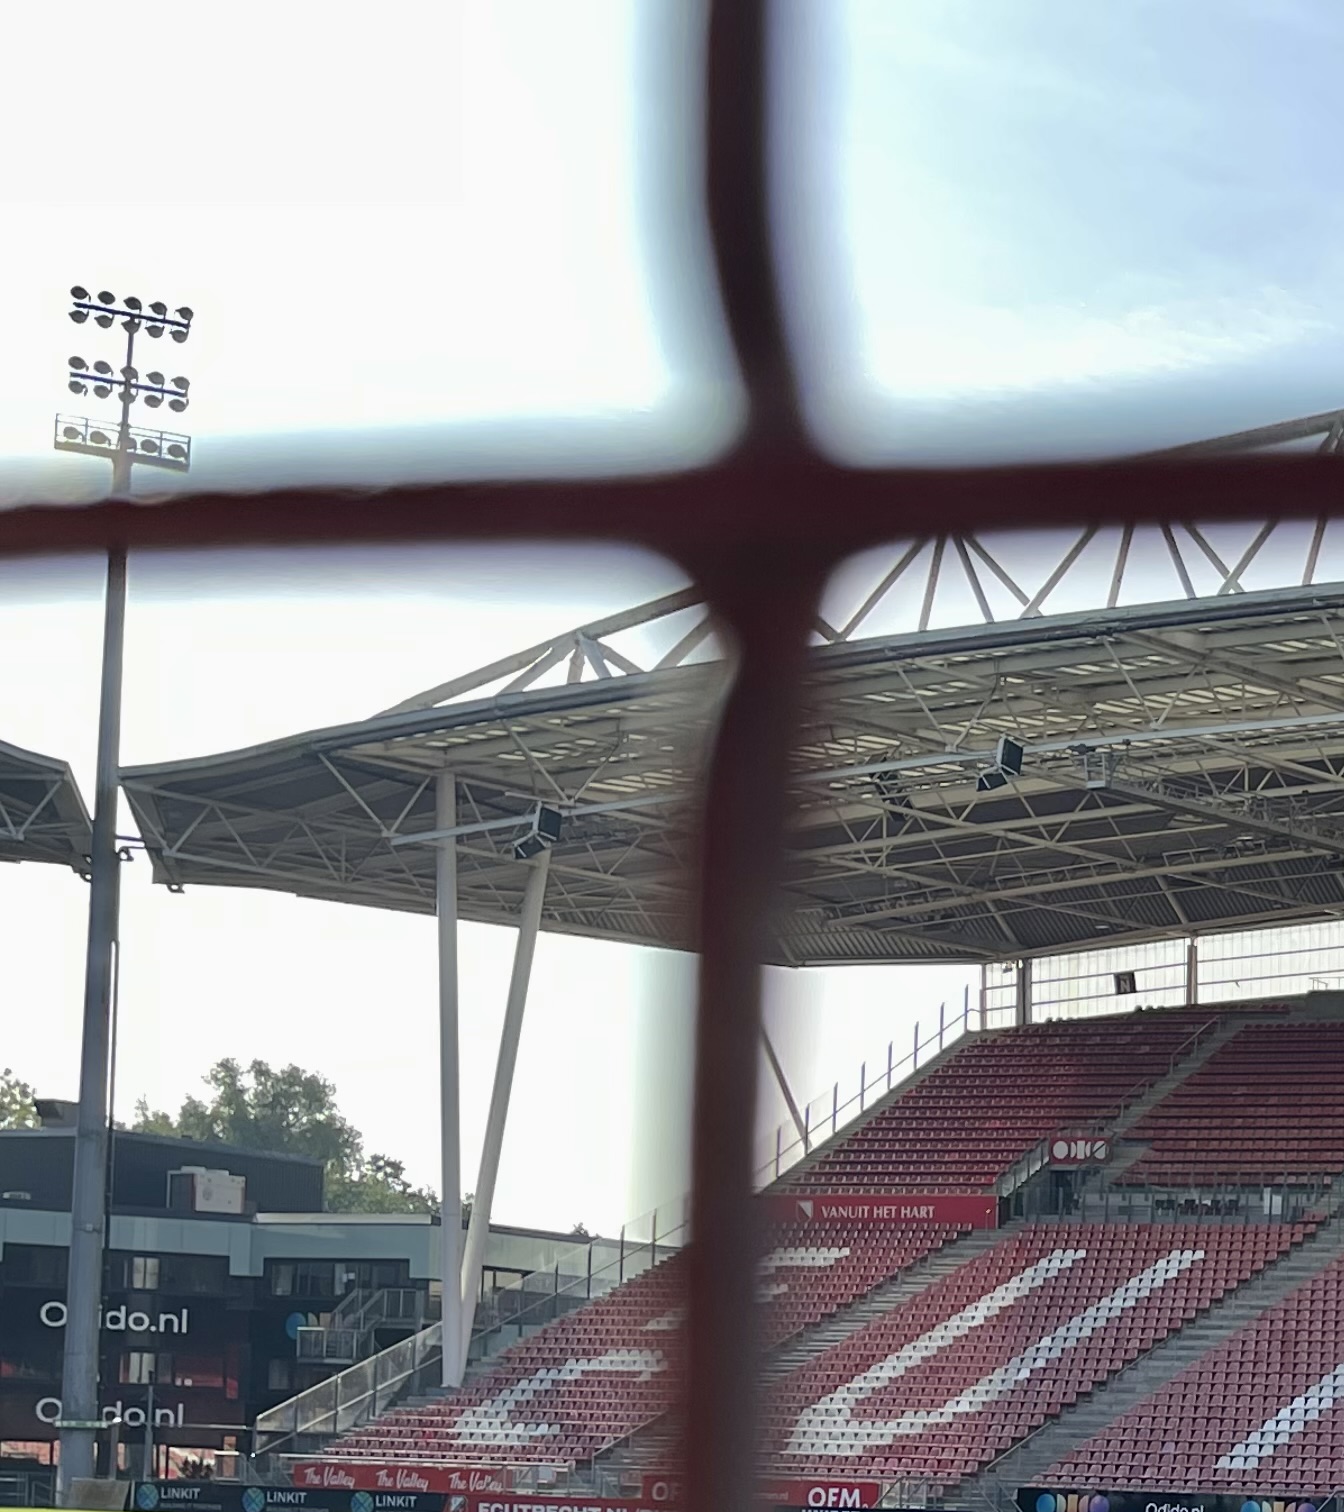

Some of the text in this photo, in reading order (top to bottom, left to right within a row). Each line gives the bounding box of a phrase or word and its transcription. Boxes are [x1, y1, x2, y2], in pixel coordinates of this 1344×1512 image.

[821, 1205, 935, 1219] VANUIT HET HART
[304, 1466, 355, 1488] The Valley
[375, 1468, 428, 1491] The Valley
[448, 1473, 467, 1489] The
[161, 1486, 200, 1499] LINKIT
[266, 1491, 307, 1504] LINKIT
[375, 1495, 417, 1508] LINKIT
